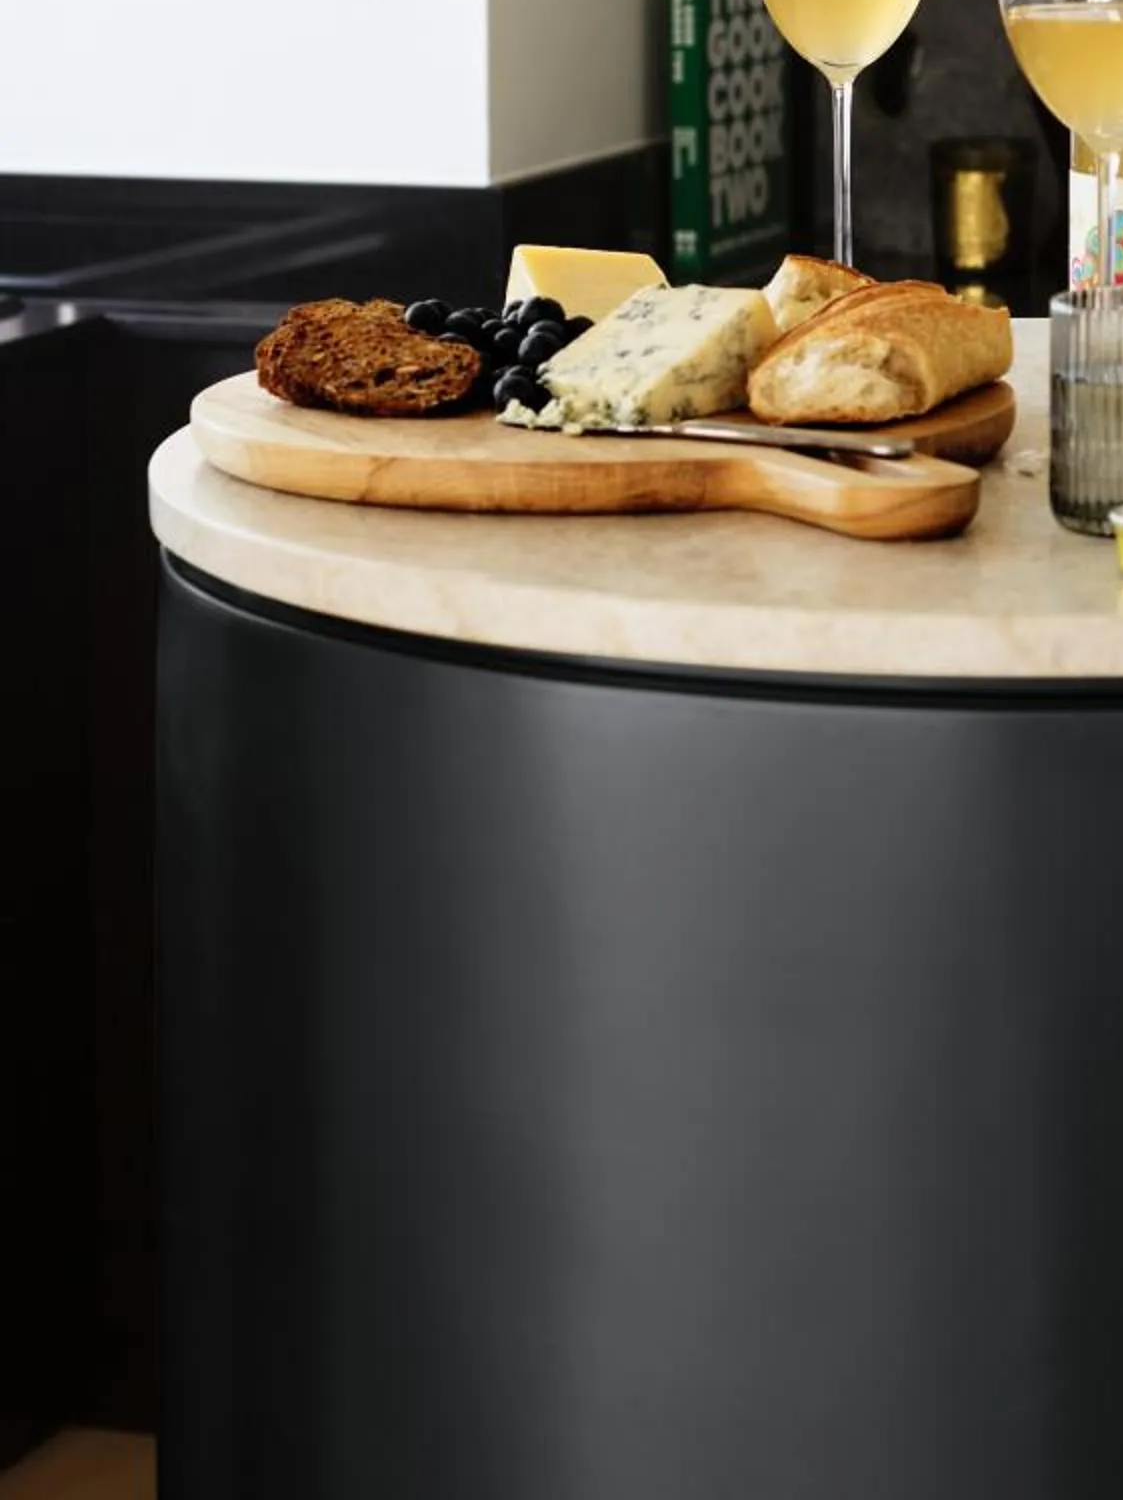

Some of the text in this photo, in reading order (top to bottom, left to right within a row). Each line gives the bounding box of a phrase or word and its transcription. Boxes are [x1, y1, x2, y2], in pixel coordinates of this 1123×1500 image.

[708, 60, 783, 121] COOK
[709, 111, 783, 174] BOOK
[710, 163, 768, 227] TWO
